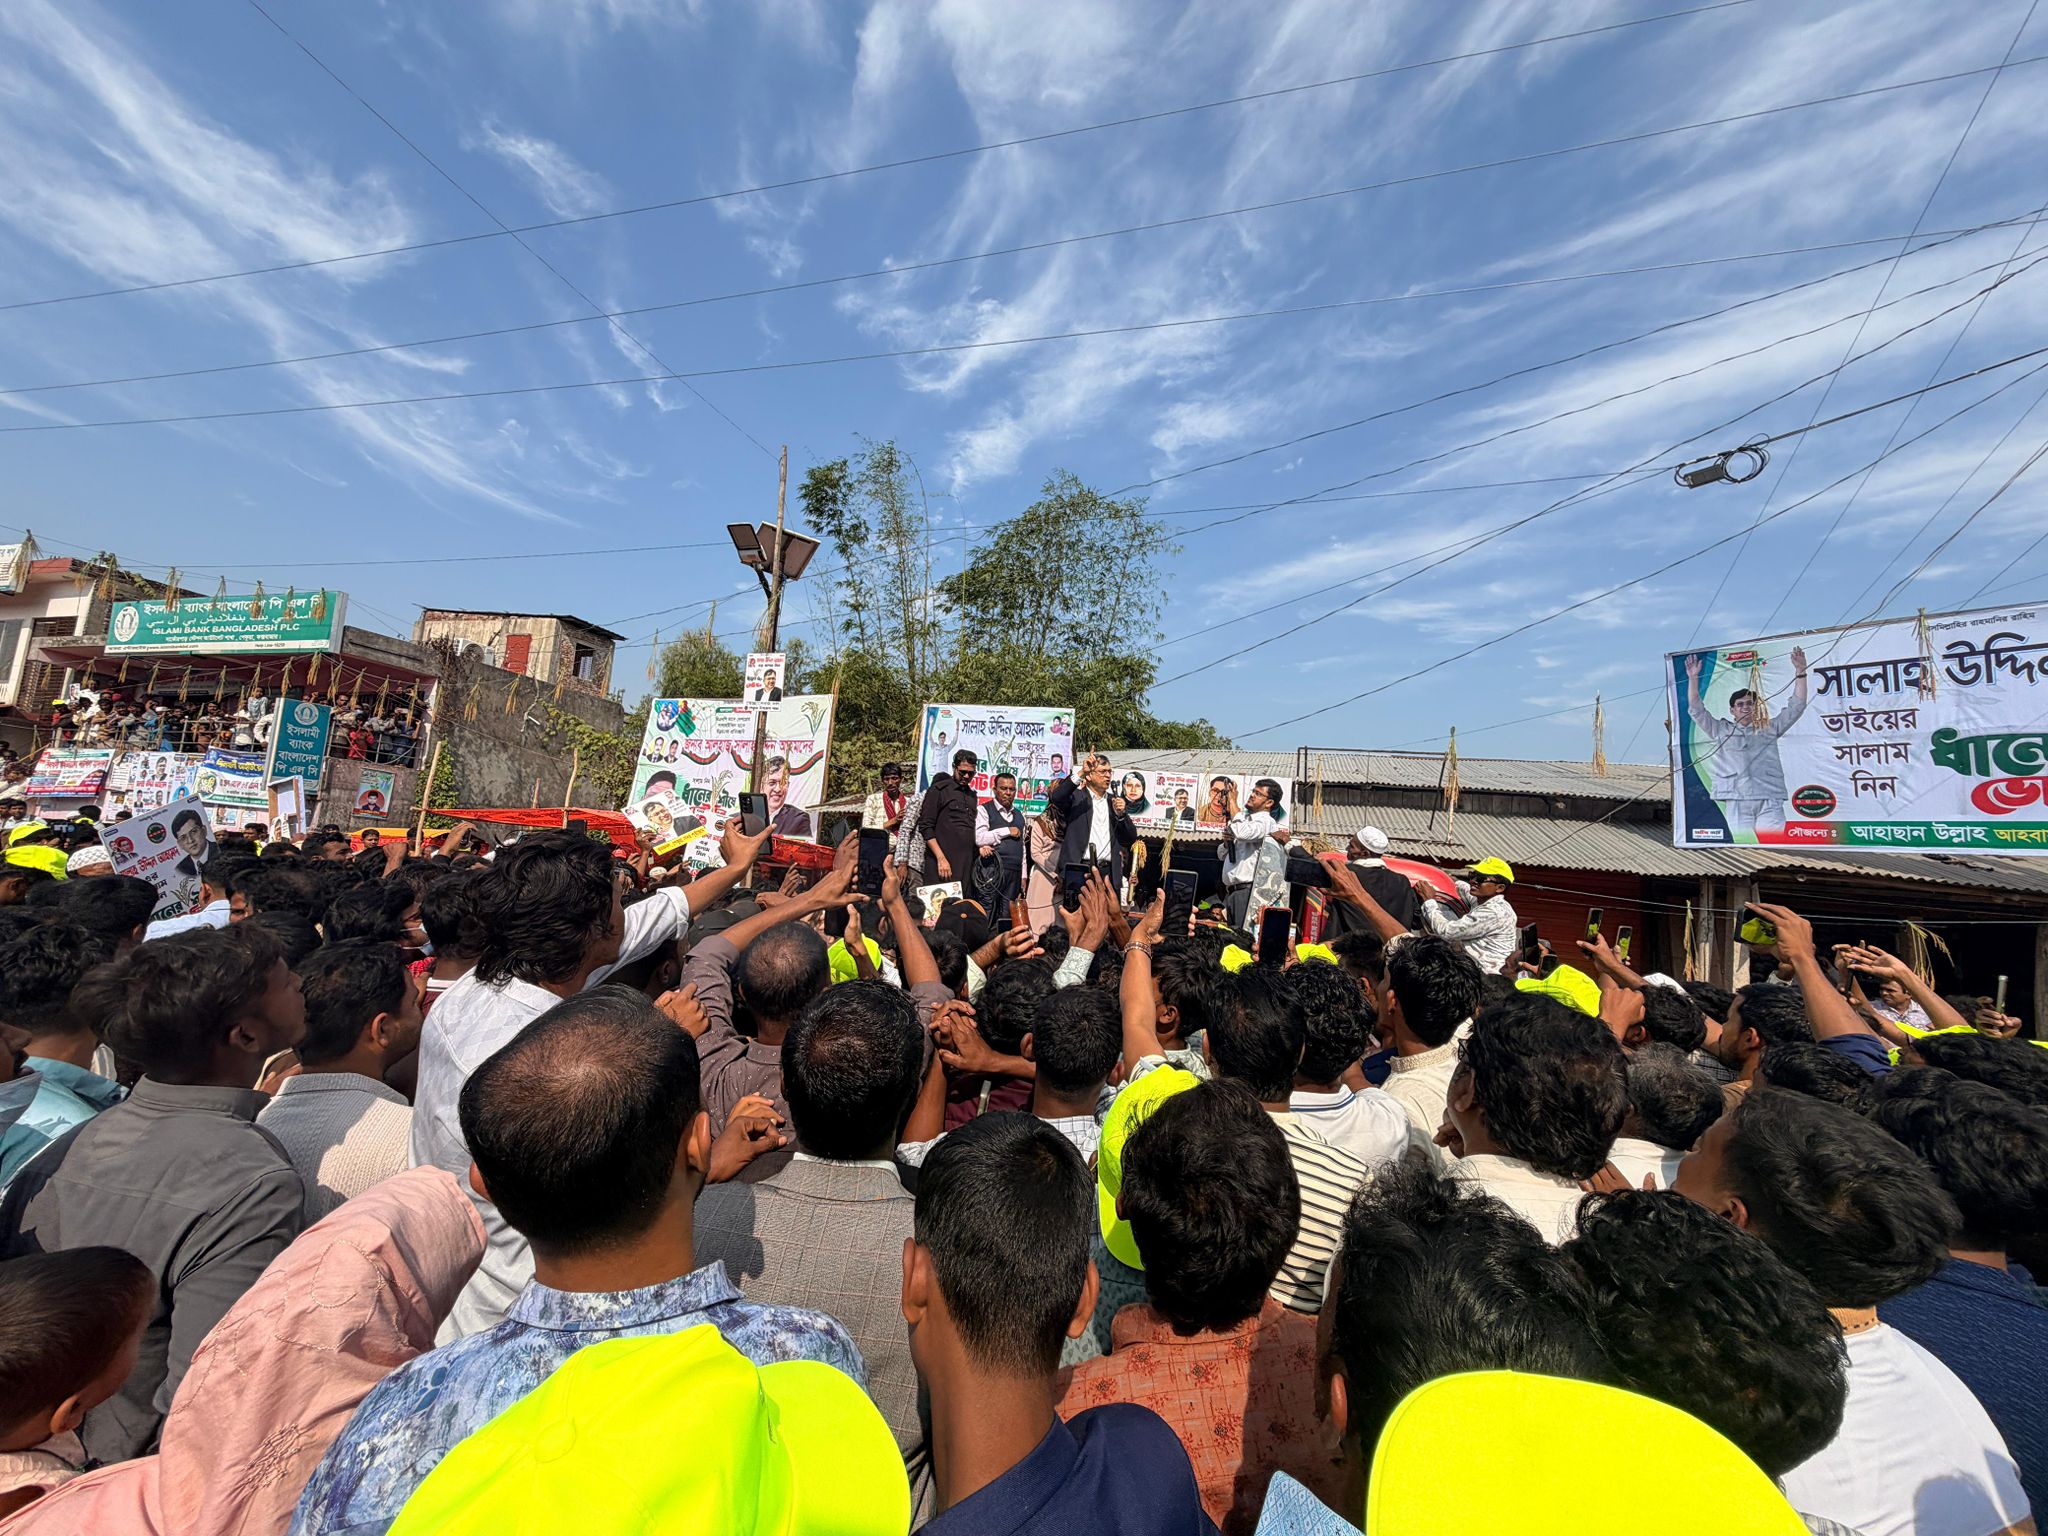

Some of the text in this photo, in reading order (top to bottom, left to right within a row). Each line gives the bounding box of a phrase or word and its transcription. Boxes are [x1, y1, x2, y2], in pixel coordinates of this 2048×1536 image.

[184, 602, 213, 613] ব্যাংক
[269, 597, 283, 609] পি
[152, 623, 299, 634] ISLAMI BANK BANGLADESH PLC
[962, 715, 1045, 737] সালাহ উদ্দিন আহমদ
[1820, 706, 1920, 734] ভাইয়ের
[286, 722, 320, 738] ইসলামী
[288, 739, 314, 750] ব্যাংক
[278, 751, 320, 763] বাংলাদেশ
[1832, 741, 1912, 766] সালাম
[275, 760, 287, 774] পি
[289, 764, 305, 775] এল
[307, 764, 318, 776] সি
[1849, 769, 1899, 799] নিন
[1787, 826, 1829, 838] সৌজন্যে
[1850, 825, 1927, 842] আহাছান
[1931, 821, 1989, 843] উল্লাহ
